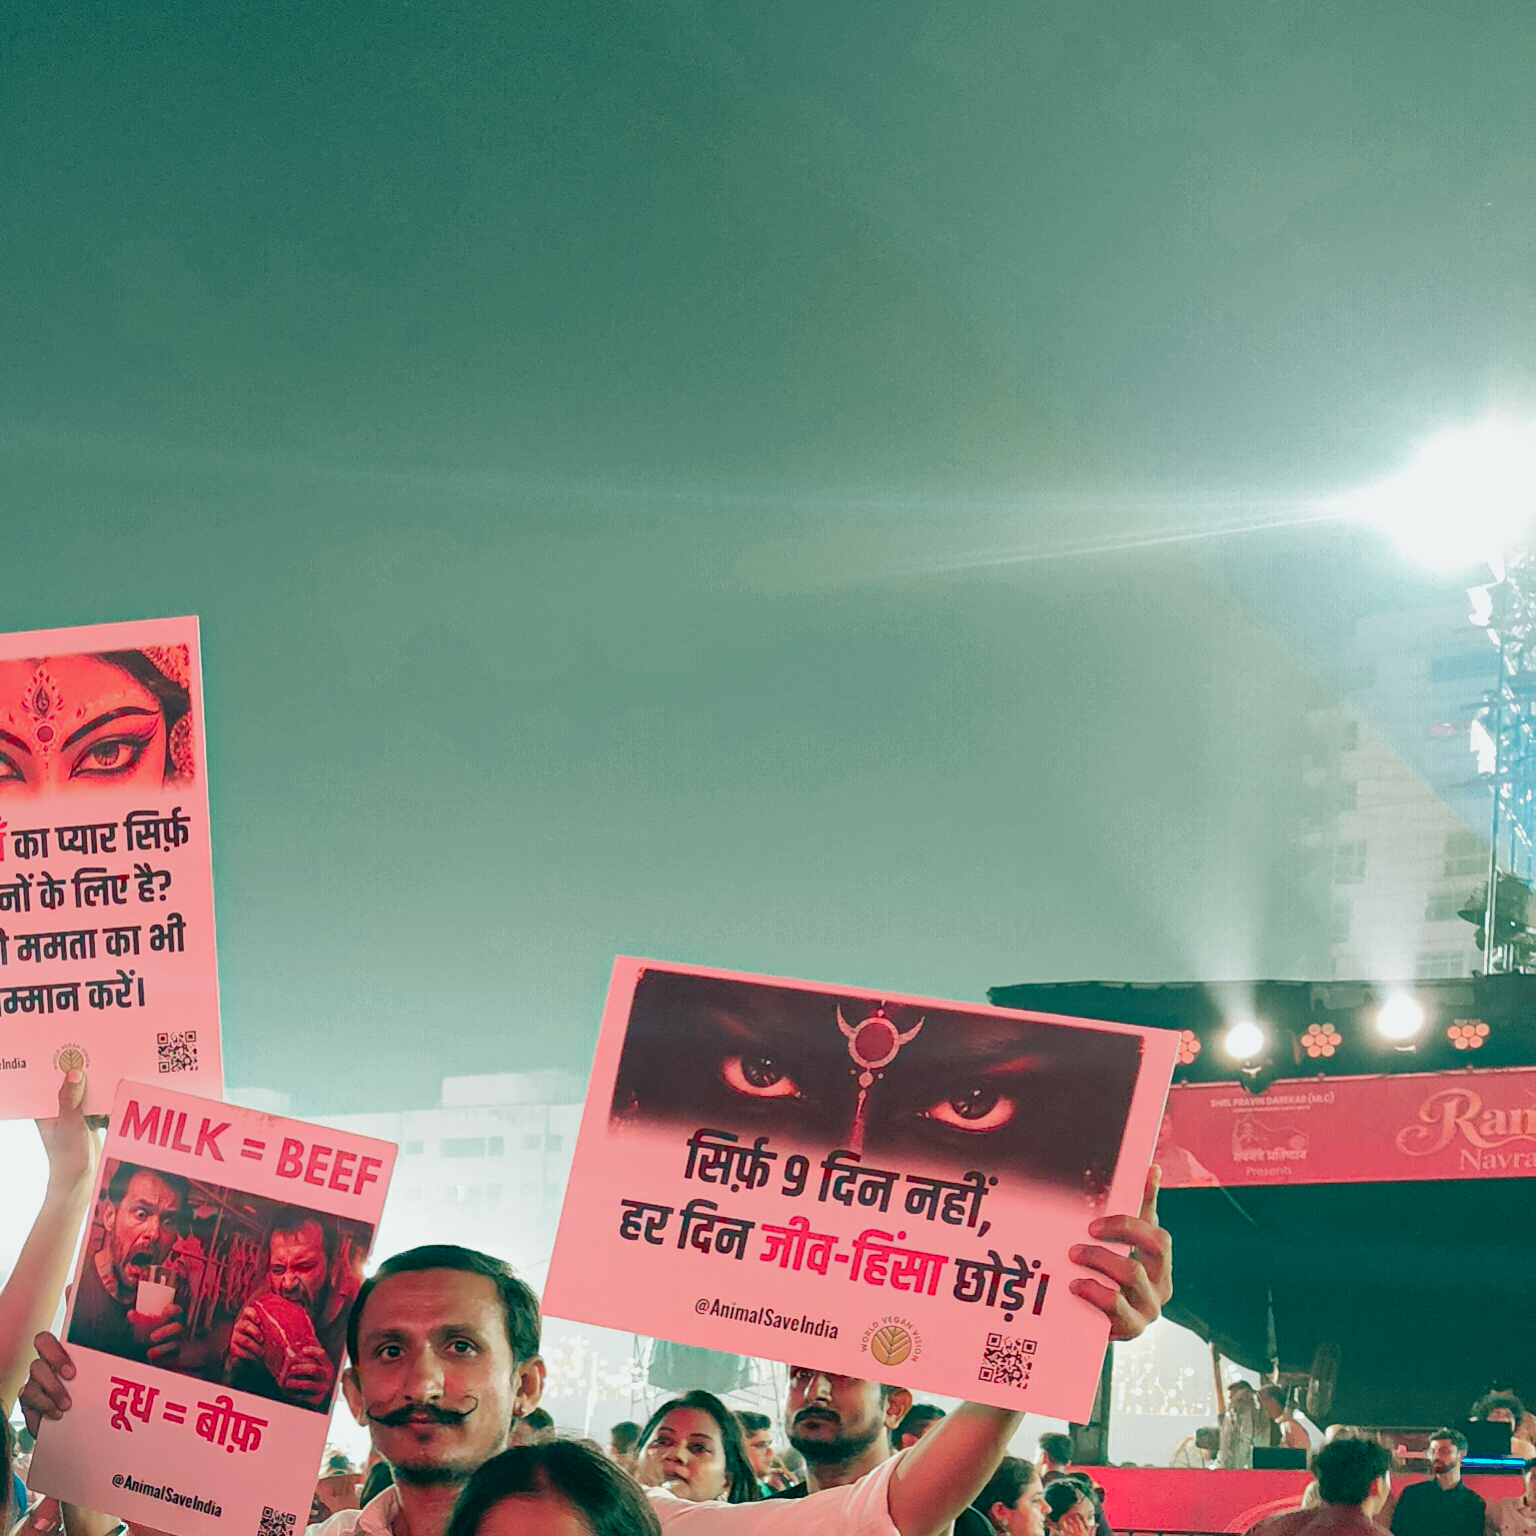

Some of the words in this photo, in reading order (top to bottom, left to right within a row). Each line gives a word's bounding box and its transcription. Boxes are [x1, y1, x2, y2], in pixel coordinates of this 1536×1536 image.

[11, 829, 49, 860] का
[55, 823, 117, 855] प्यार
[37, 871, 66, 911] के
[71, 867, 130, 909] लिए
[134, 864, 172, 903] है?
[14, 928, 97, 963] ममता
[102, 925, 141, 957] का
[149, 913, 185, 953] भी
[119, 1100, 231, 1162] MILK
[275, 1138, 382, 1196] BEEF
[783, 1154, 807, 1197] 9
[818, 1149, 898, 1213] दिन
[904, 1172, 999, 1238] नहीं,
[619, 1198, 673, 1247] हर
[676, 1198, 755, 1261] दिन
[758, 1215, 949, 1297] जीव-हिंसा
[694, 1297, 840, 1341] @AnimalSaveIndia
[861, 1321, 879, 1352] WORLD
[882, 1316, 914, 1330] VEGAN
[107, 1376, 160, 1432] दूध
[111, 1473, 222, 1518] @AnimalSaveIndia
